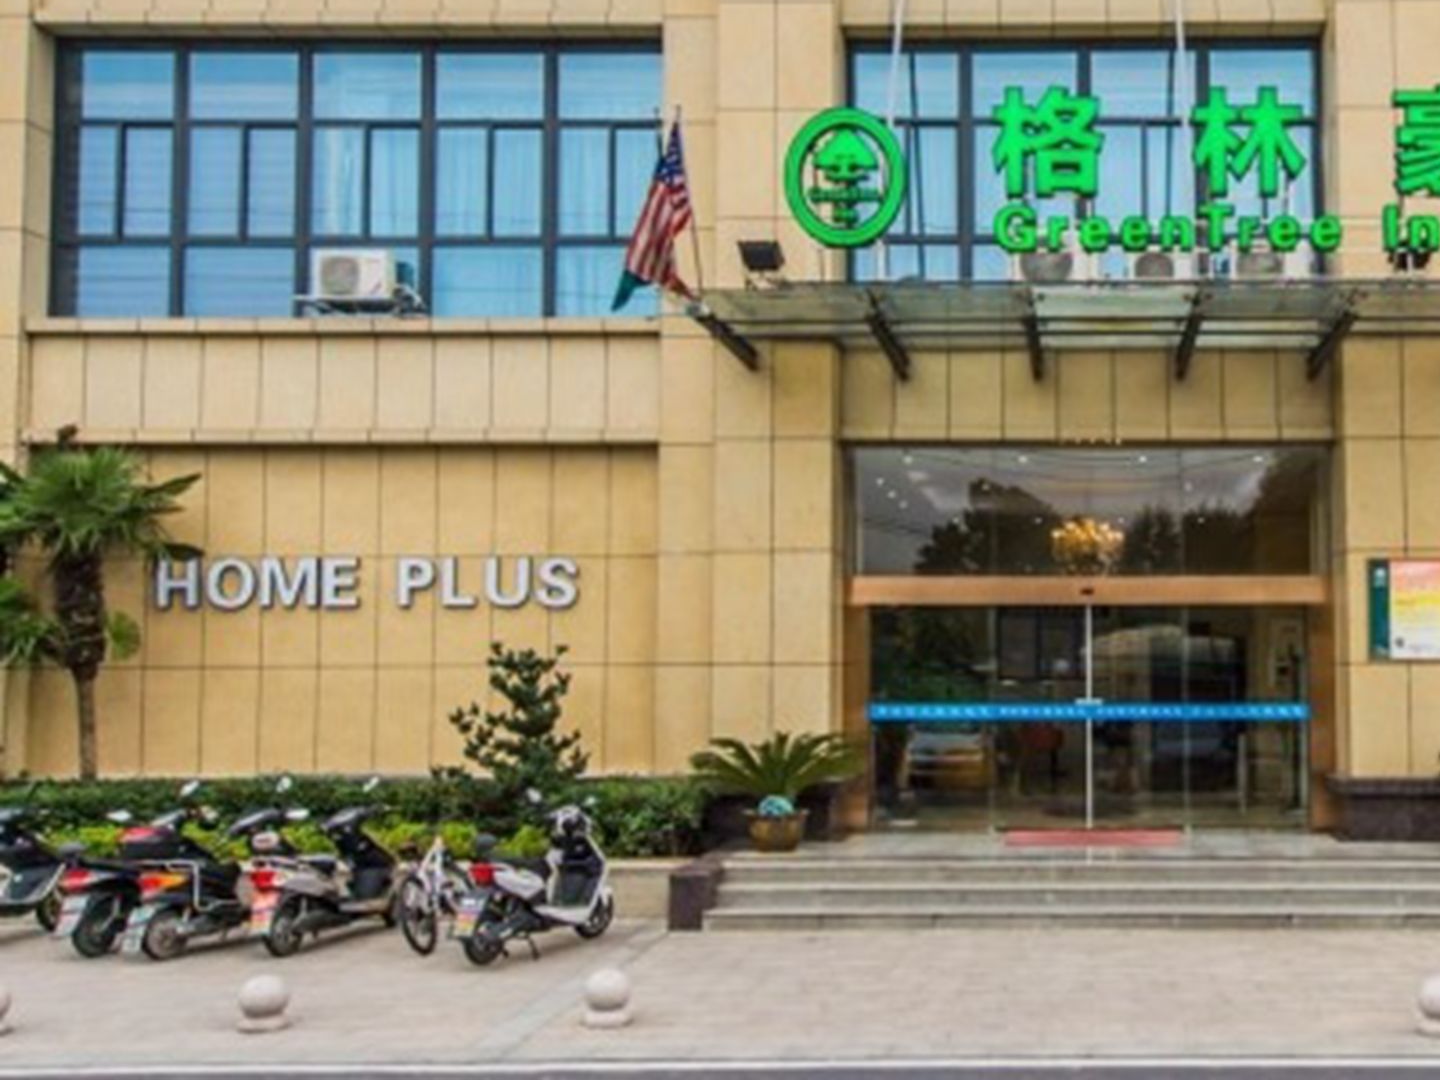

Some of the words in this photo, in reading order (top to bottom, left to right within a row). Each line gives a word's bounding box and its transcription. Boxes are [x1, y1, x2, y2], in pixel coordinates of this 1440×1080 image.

[993, 202, 1343, 254] GreenTree
[155, 553, 361, 610] HOME
[397, 553, 580, 610] PLUS
